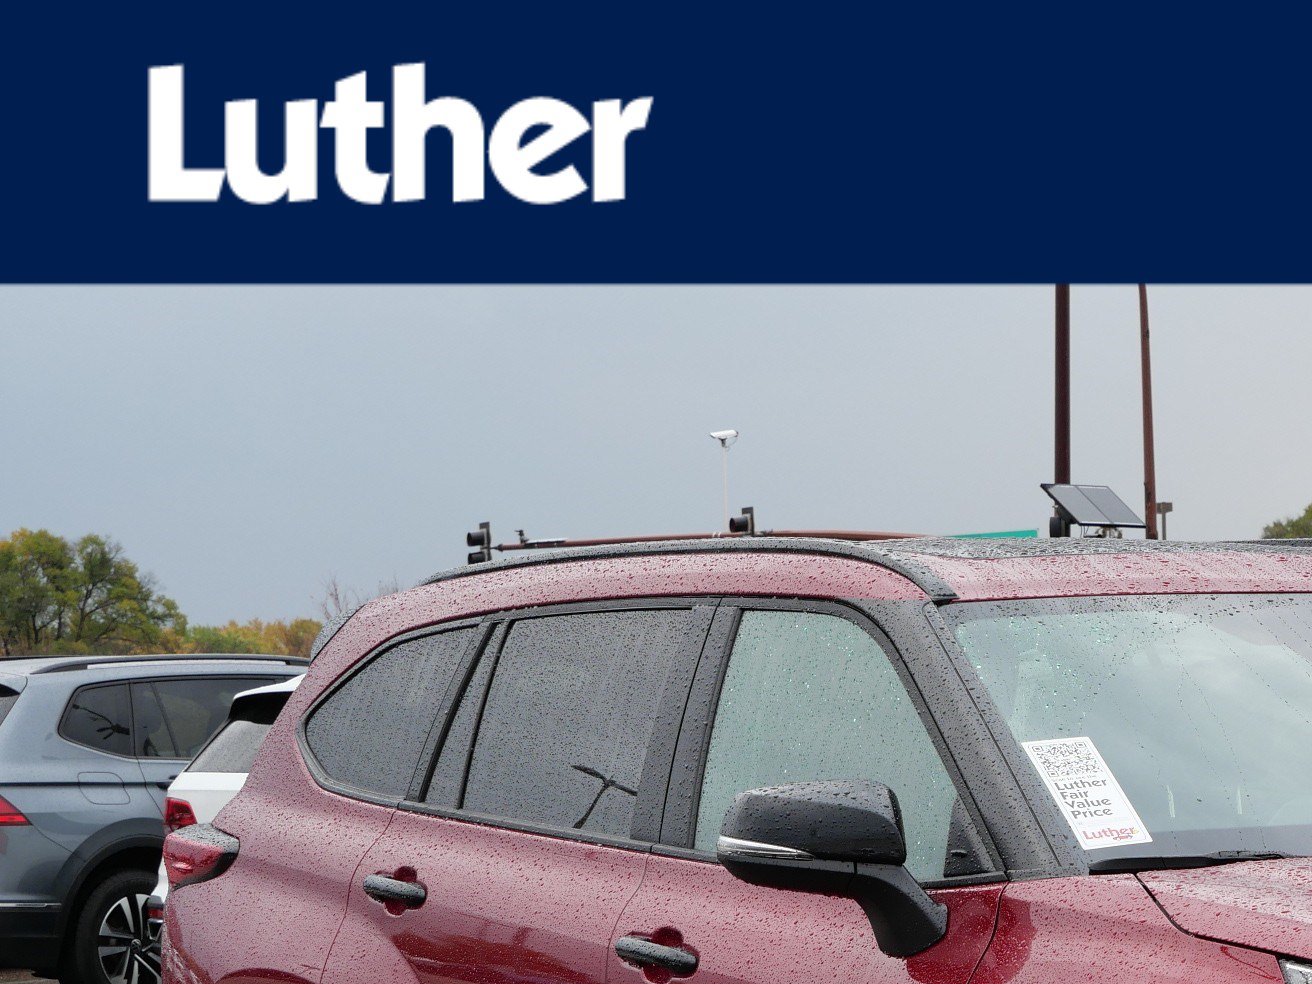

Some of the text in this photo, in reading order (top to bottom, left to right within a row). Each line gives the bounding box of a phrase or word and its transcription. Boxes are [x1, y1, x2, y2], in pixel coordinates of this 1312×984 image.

[1054, 779, 1107, 791] Luther
[1060, 790, 1089, 800] Fair
[1064, 798, 1112, 809] Value
[1070, 808, 1113, 819] Price
[1082, 827, 1135, 840] Luther
